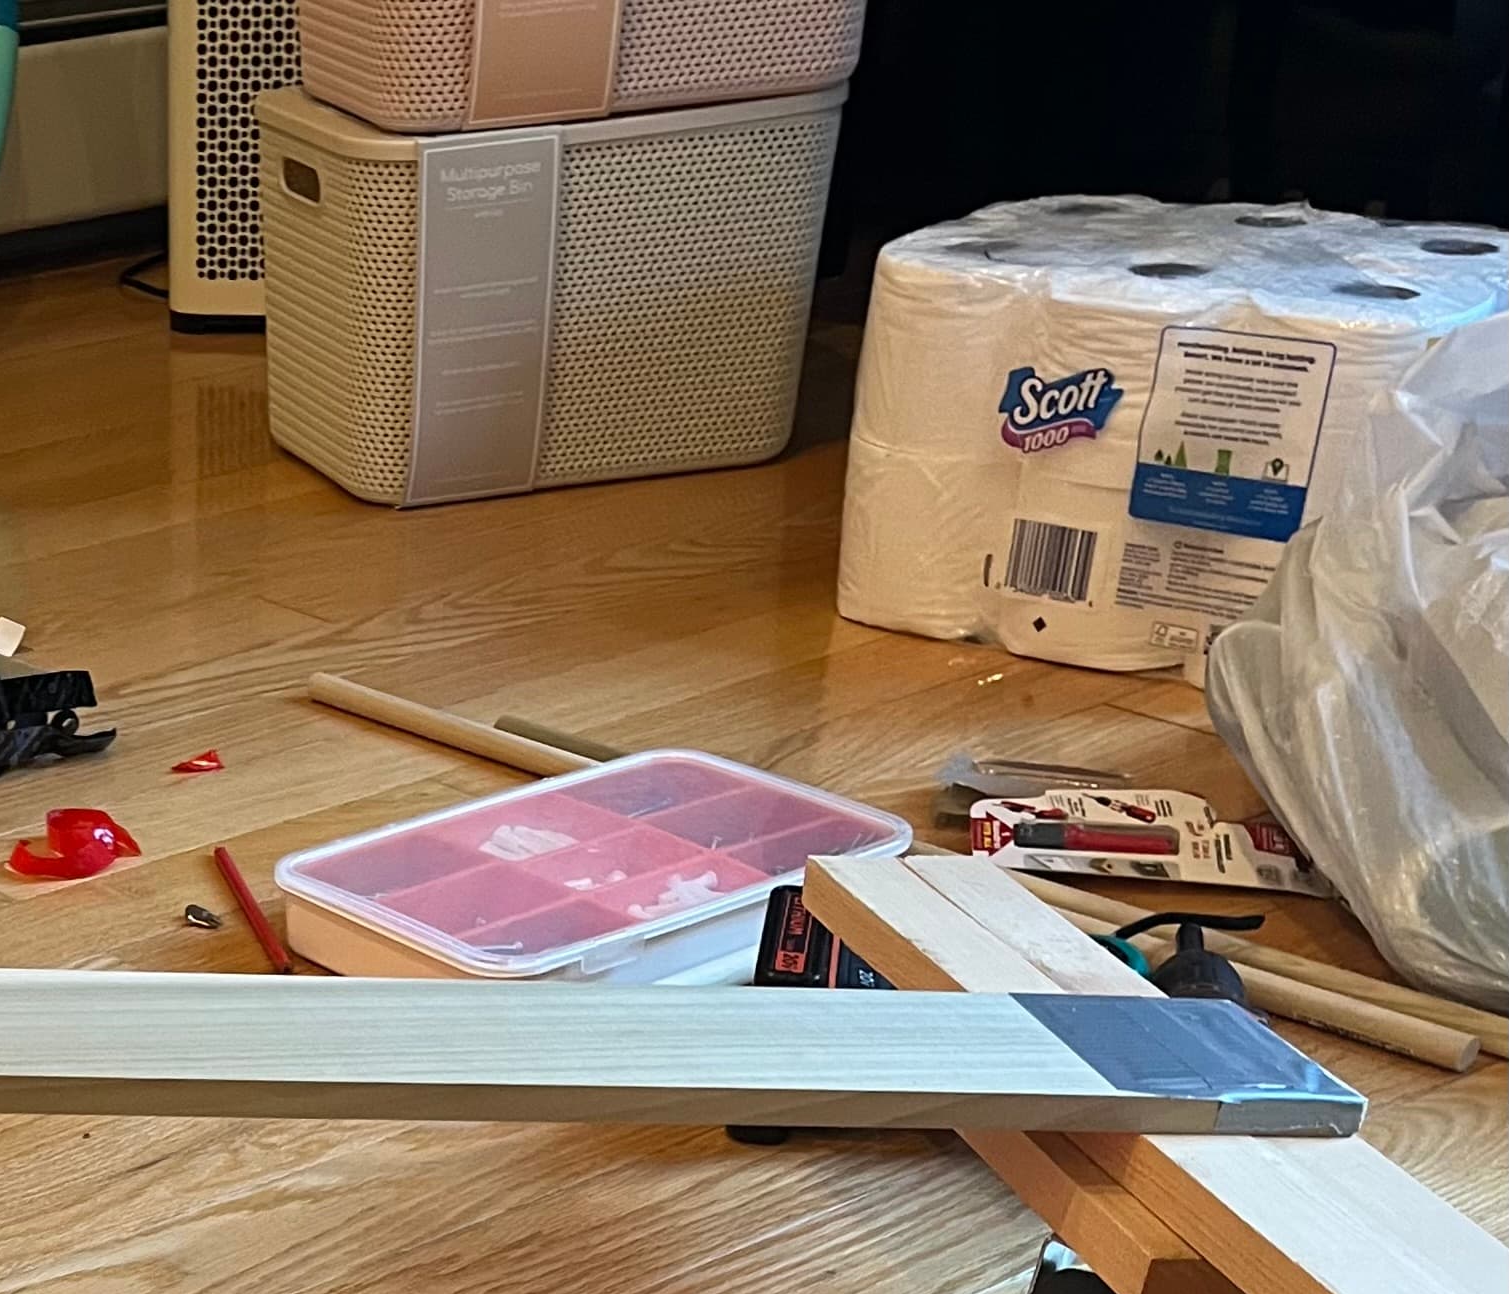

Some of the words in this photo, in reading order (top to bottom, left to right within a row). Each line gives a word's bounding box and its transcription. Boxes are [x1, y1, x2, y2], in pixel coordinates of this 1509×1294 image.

[440, 161, 541, 183] Multipurpose
[446, 186, 506, 202] Storage
[509, 178, 533, 196] Bin
[1013, 370, 1108, 425] Scott
[1023, 426, 1069, 453] 1000
